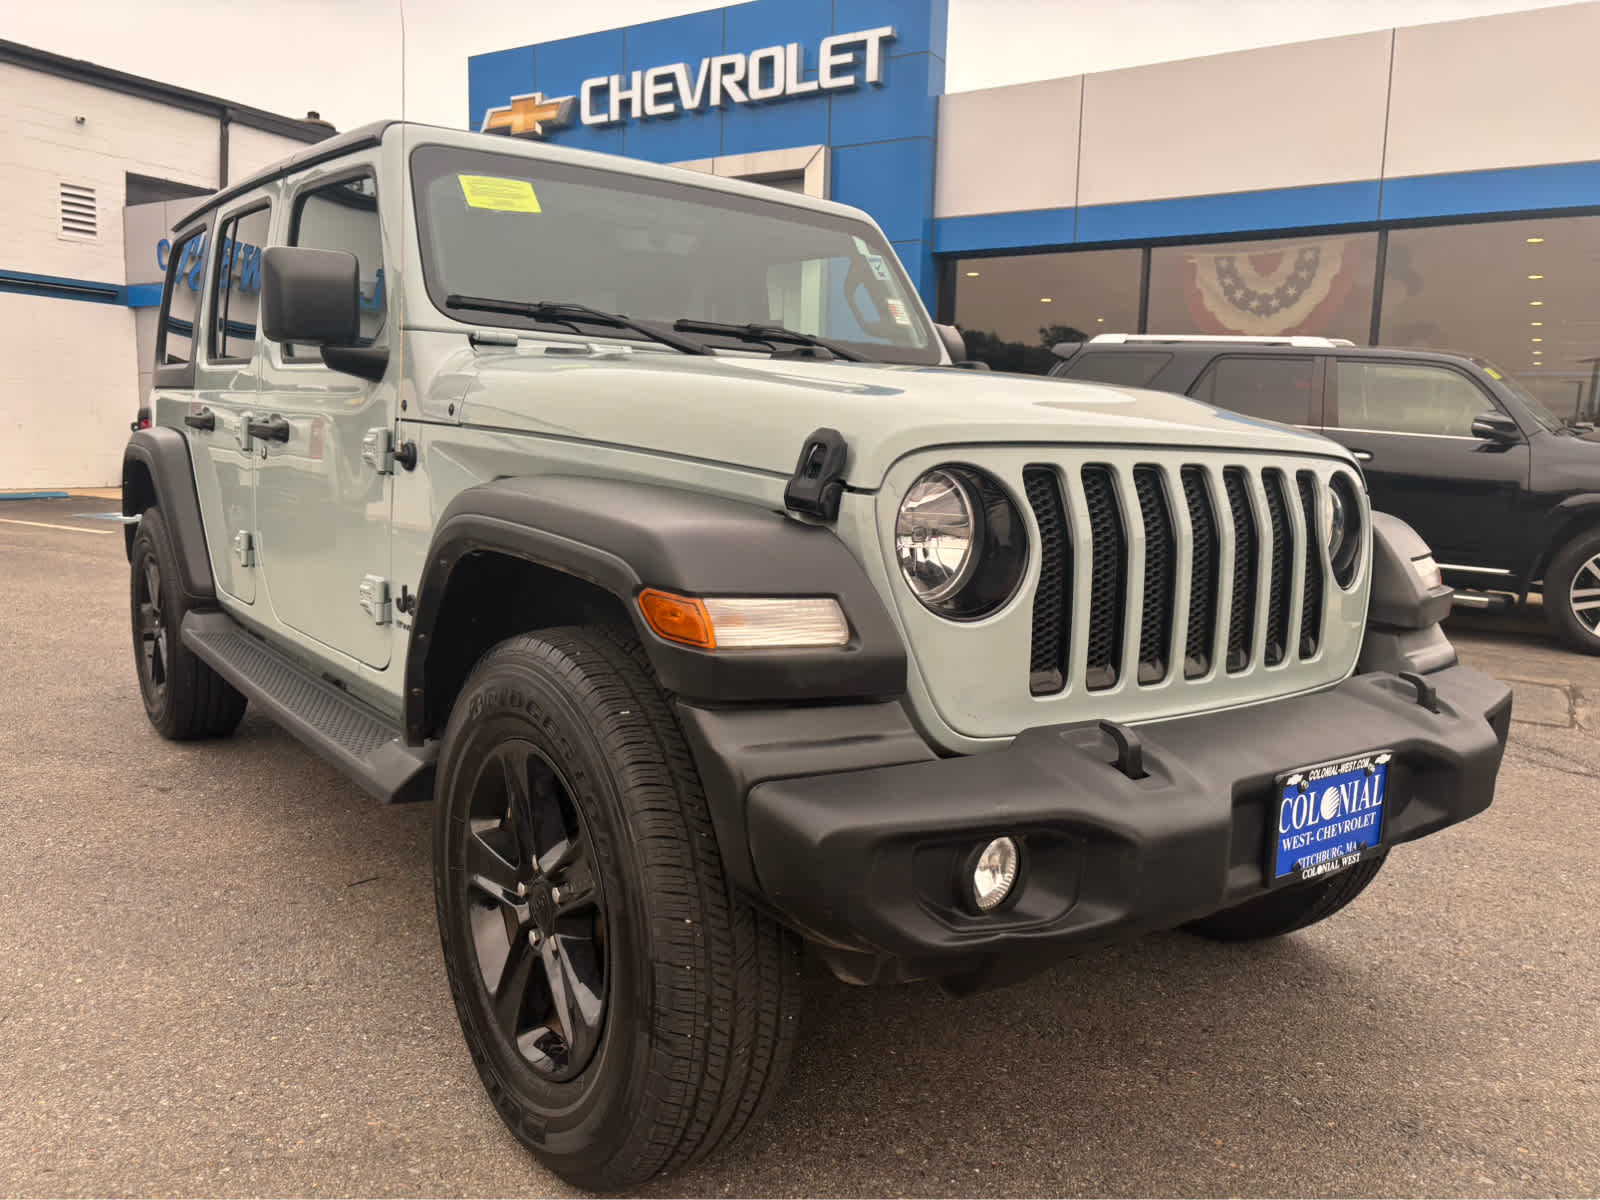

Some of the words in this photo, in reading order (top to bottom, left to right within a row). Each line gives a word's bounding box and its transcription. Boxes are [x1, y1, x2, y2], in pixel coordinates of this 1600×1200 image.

[580, 26, 896, 125] CHEVROLET
[1279, 774, 1383, 834] COLONIAL
[1316, 812, 1377, 841] CHEVROLET
[1302, 859, 1340, 880] COLONIAL
[1341, 853, 1361, 866] WEST
